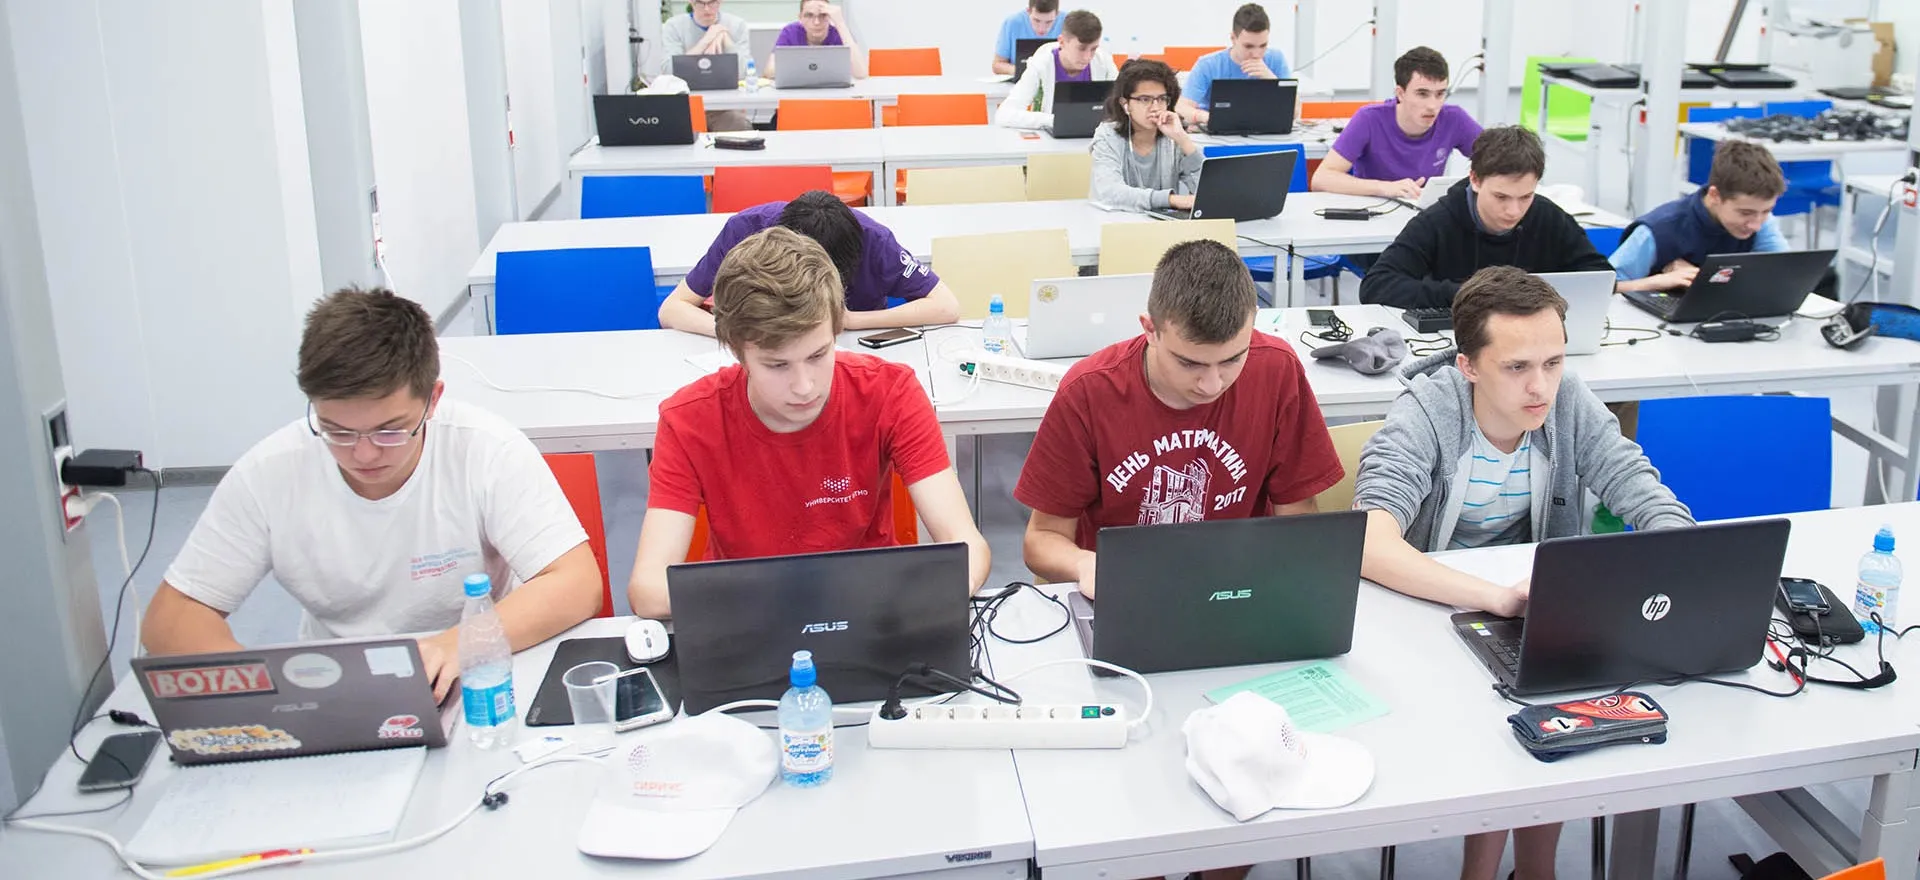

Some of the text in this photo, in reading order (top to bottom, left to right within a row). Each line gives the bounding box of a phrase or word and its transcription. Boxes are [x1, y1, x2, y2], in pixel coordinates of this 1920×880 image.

[629, 116, 660, 125] VAIO
[1106, 451, 1151, 494] ДЕНЬ
[805, 494, 852, 508] УНИВЕРСИТЕТ
[1213, 486, 1247, 511] 2017
[1209, 589, 1252, 601] ASUS
[1644, 594, 1669, 621] hp
[801, 621, 849, 634] ASUS
[156, 664, 264, 696] BOTAY
